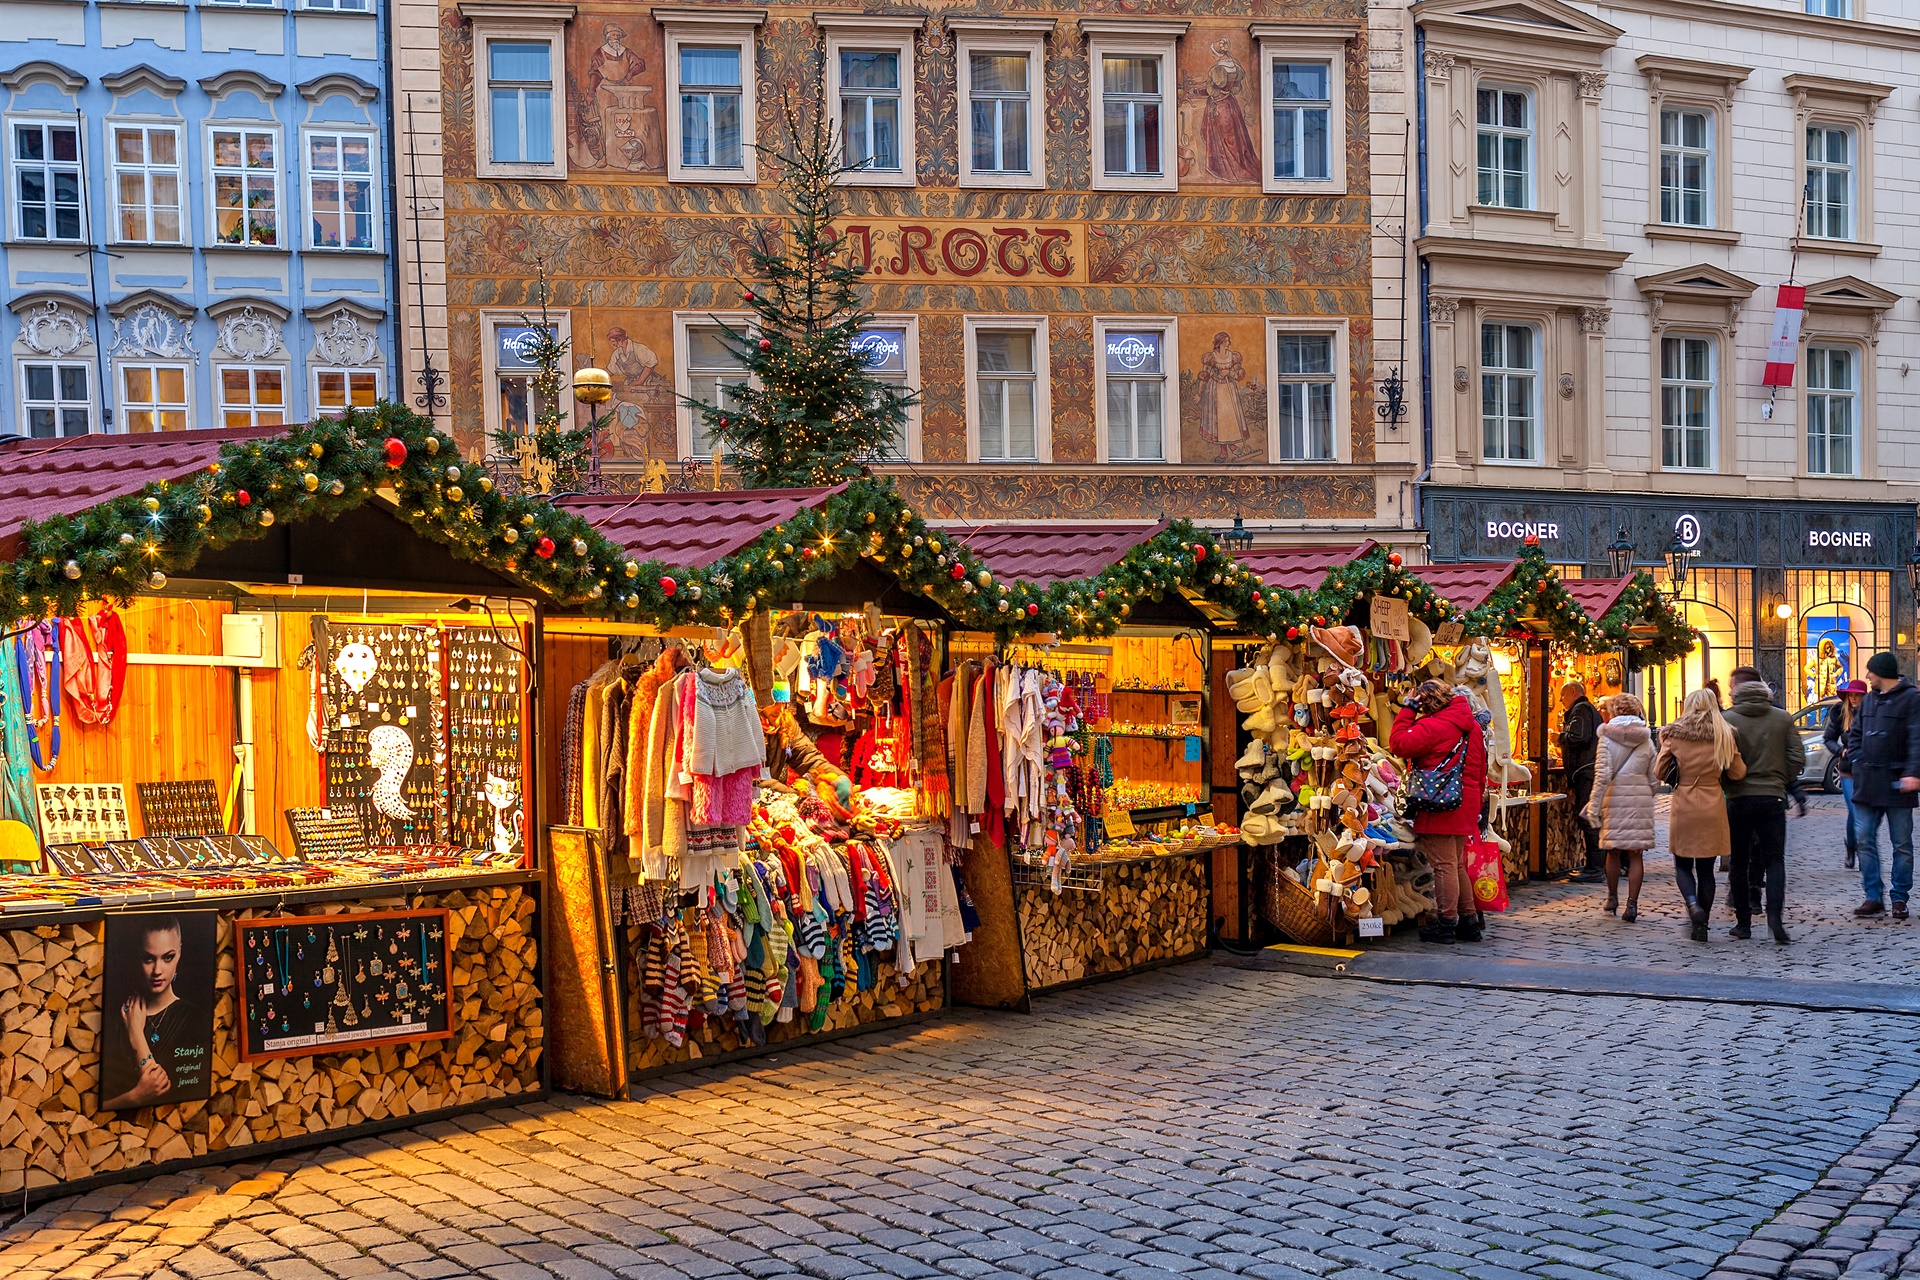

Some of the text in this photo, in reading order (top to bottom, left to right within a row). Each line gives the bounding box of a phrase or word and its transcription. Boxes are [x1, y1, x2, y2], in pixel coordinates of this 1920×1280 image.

[876, 341, 899, 355] Rock
[1107, 343, 1155, 357] Hard Rock
[1487, 521, 1559, 539] BOGNER
[1809, 530, 1872, 547] BOGNER
[1373, 598, 1391, 616] SHEEP
[1373, 618, 1392, 636] WOOL
[266, 1038, 286, 1049] Stanja
[287, 1035, 311, 1047] original
[174, 1045, 204, 1058] Stanja
[175, 1062, 202, 1074] original
[177, 1076, 199, 1088] jewels
